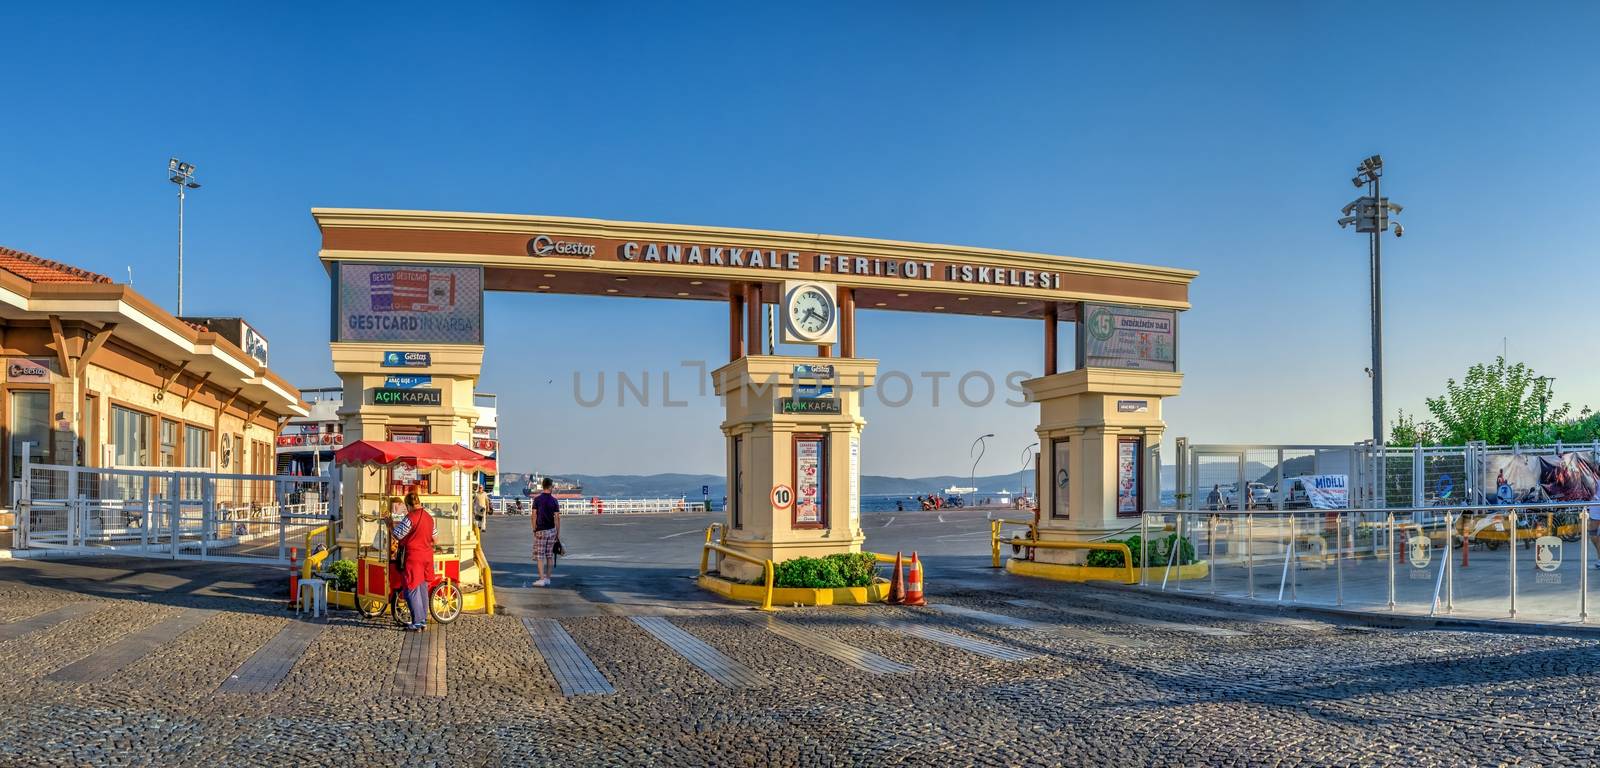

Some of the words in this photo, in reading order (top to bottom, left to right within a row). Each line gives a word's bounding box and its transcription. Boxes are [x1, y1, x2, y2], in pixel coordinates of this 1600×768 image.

[555, 240, 596, 257] Gestaş
[375, 392, 401, 402] AÇIK
[402, 392, 440, 402] KAPALI
[775, 490, 790, 504] 10
